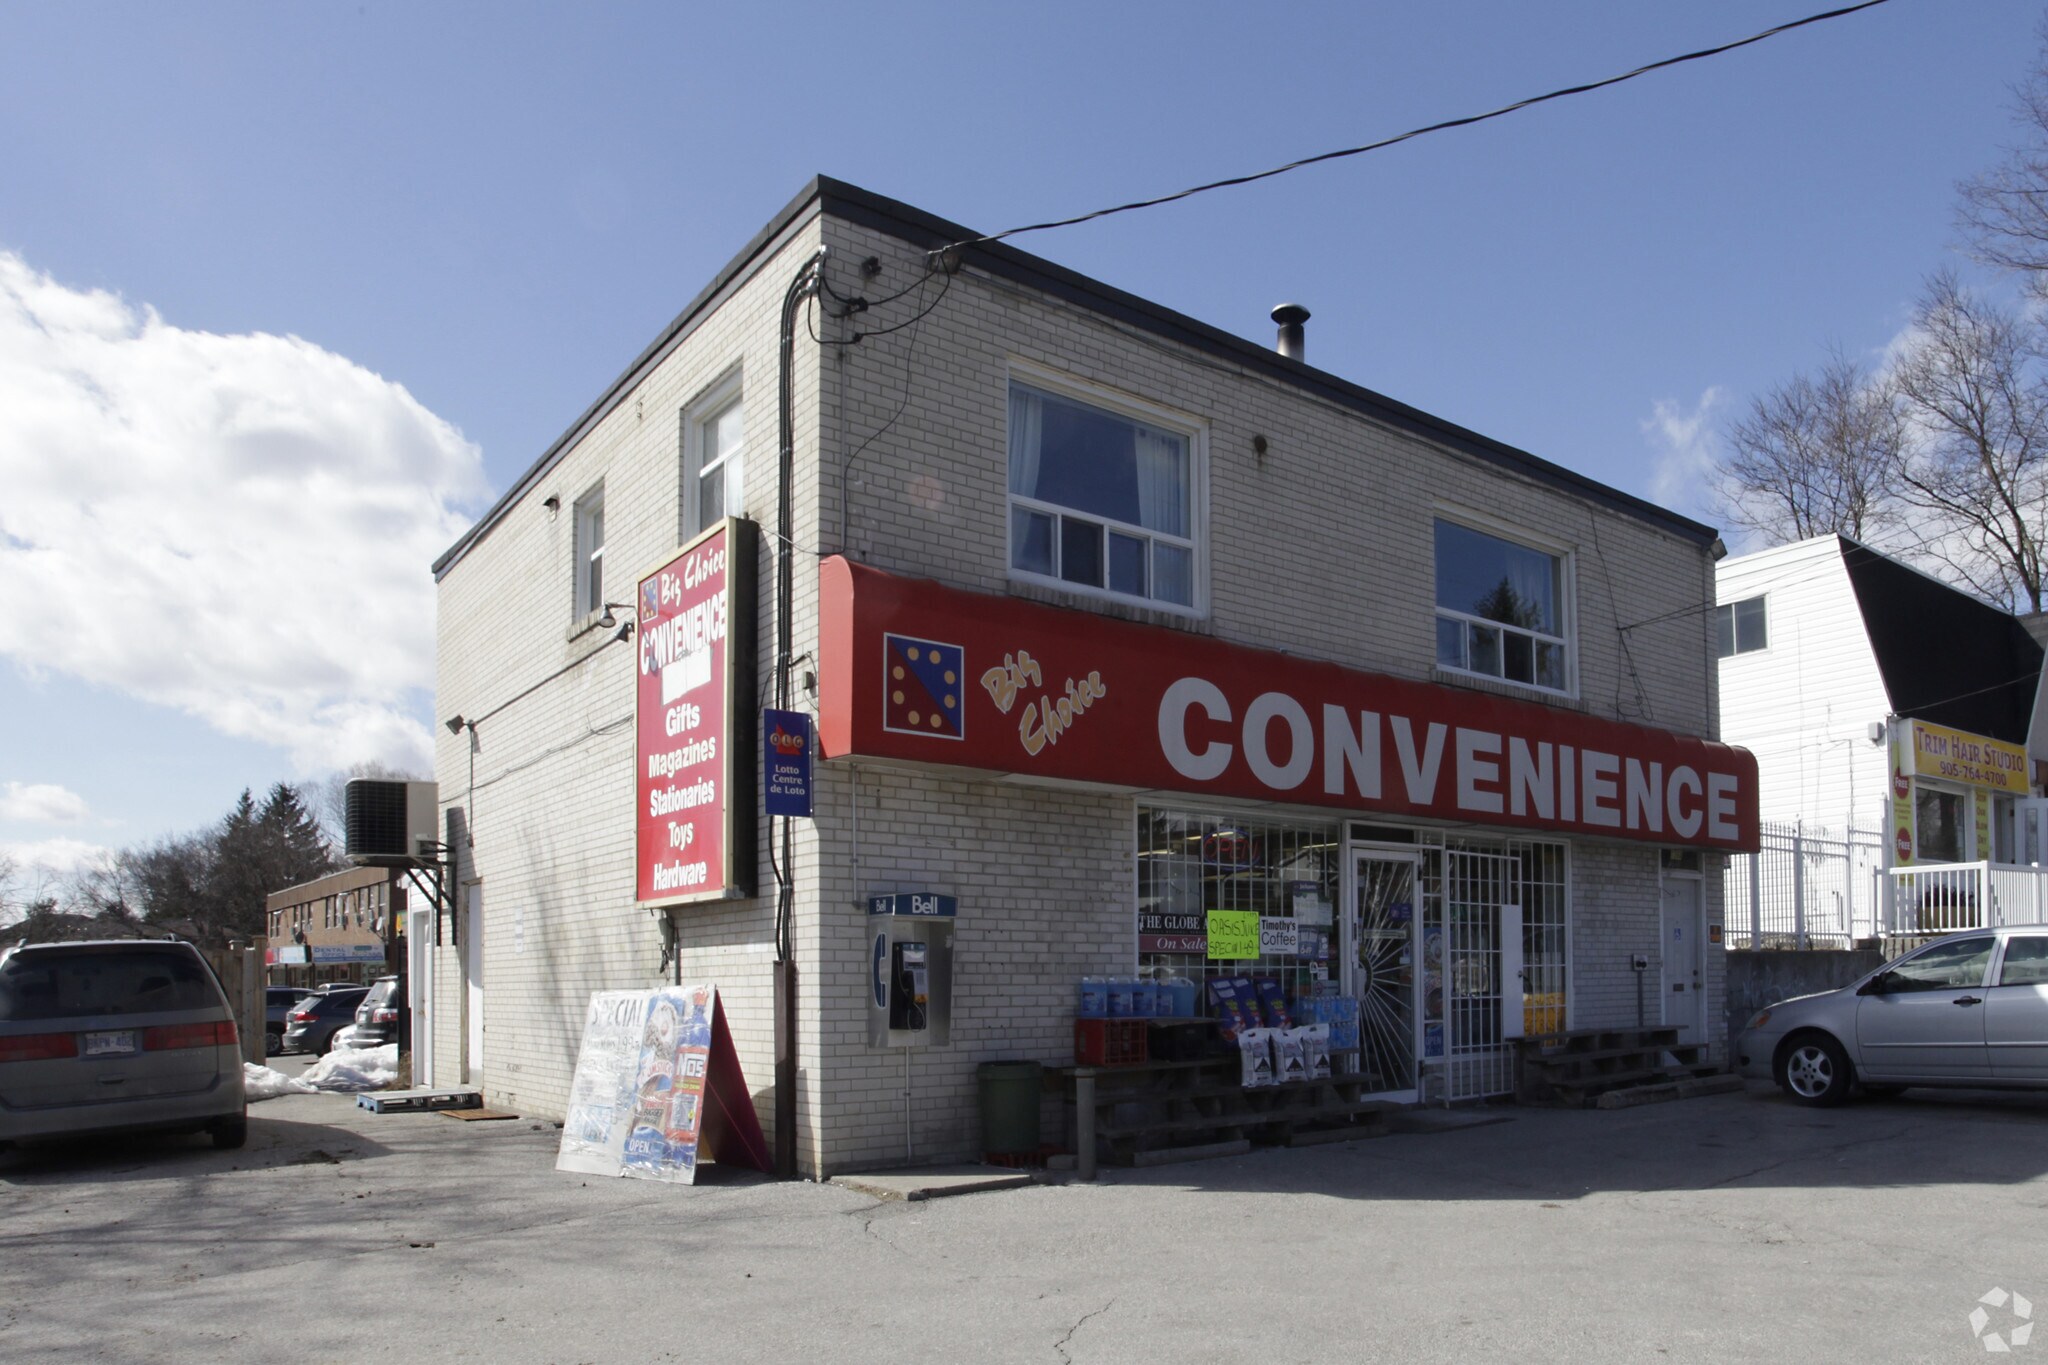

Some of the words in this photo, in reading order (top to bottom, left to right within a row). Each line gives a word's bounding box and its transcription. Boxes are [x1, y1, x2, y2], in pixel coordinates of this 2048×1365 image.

[662, 573, 681, 607] Big
[685, 546, 726, 591] Choice
[641, 588, 726, 675] CONVENIENCE
[981, 650, 1042, 714] Big
[665, 702, 700, 737] Gifts
[1019, 671, 1106, 756] Choice
[771, 734, 803, 748] OLG
[1916, 726, 1947, 756] TRIM
[1952, 735, 1981, 764] HAIR
[1984, 743, 2024, 773] STUDIO
[648, 737, 716, 778] Magazines
[775, 764, 800, 775] Lotto
[1157, 677, 1740, 840] CONVENIENCE
[770, 784, 782, 794] de
[784, 785, 806, 796] Loto
[772, 774, 803, 785] Centre
[650, 777, 715, 818] Stationaries
[668, 820, 694, 852] Toys
[1203, 837, 1262, 861] OPEN
[653, 860, 707, 891] Hardware
[912, 895, 938, 914] Bell
[1139, 915, 1161, 931] THE
[1164, 915, 1200, 930] GLOBE
[1261, 919, 1296, 933] Timothy's
[1157, 937, 1176, 950] On
[1180, 937, 1207, 951] Sale
[1261, 932, 1297, 946] Coffee
[677, 1053, 707, 1078] NOS
[629, 1139, 650, 1154] OPEN
